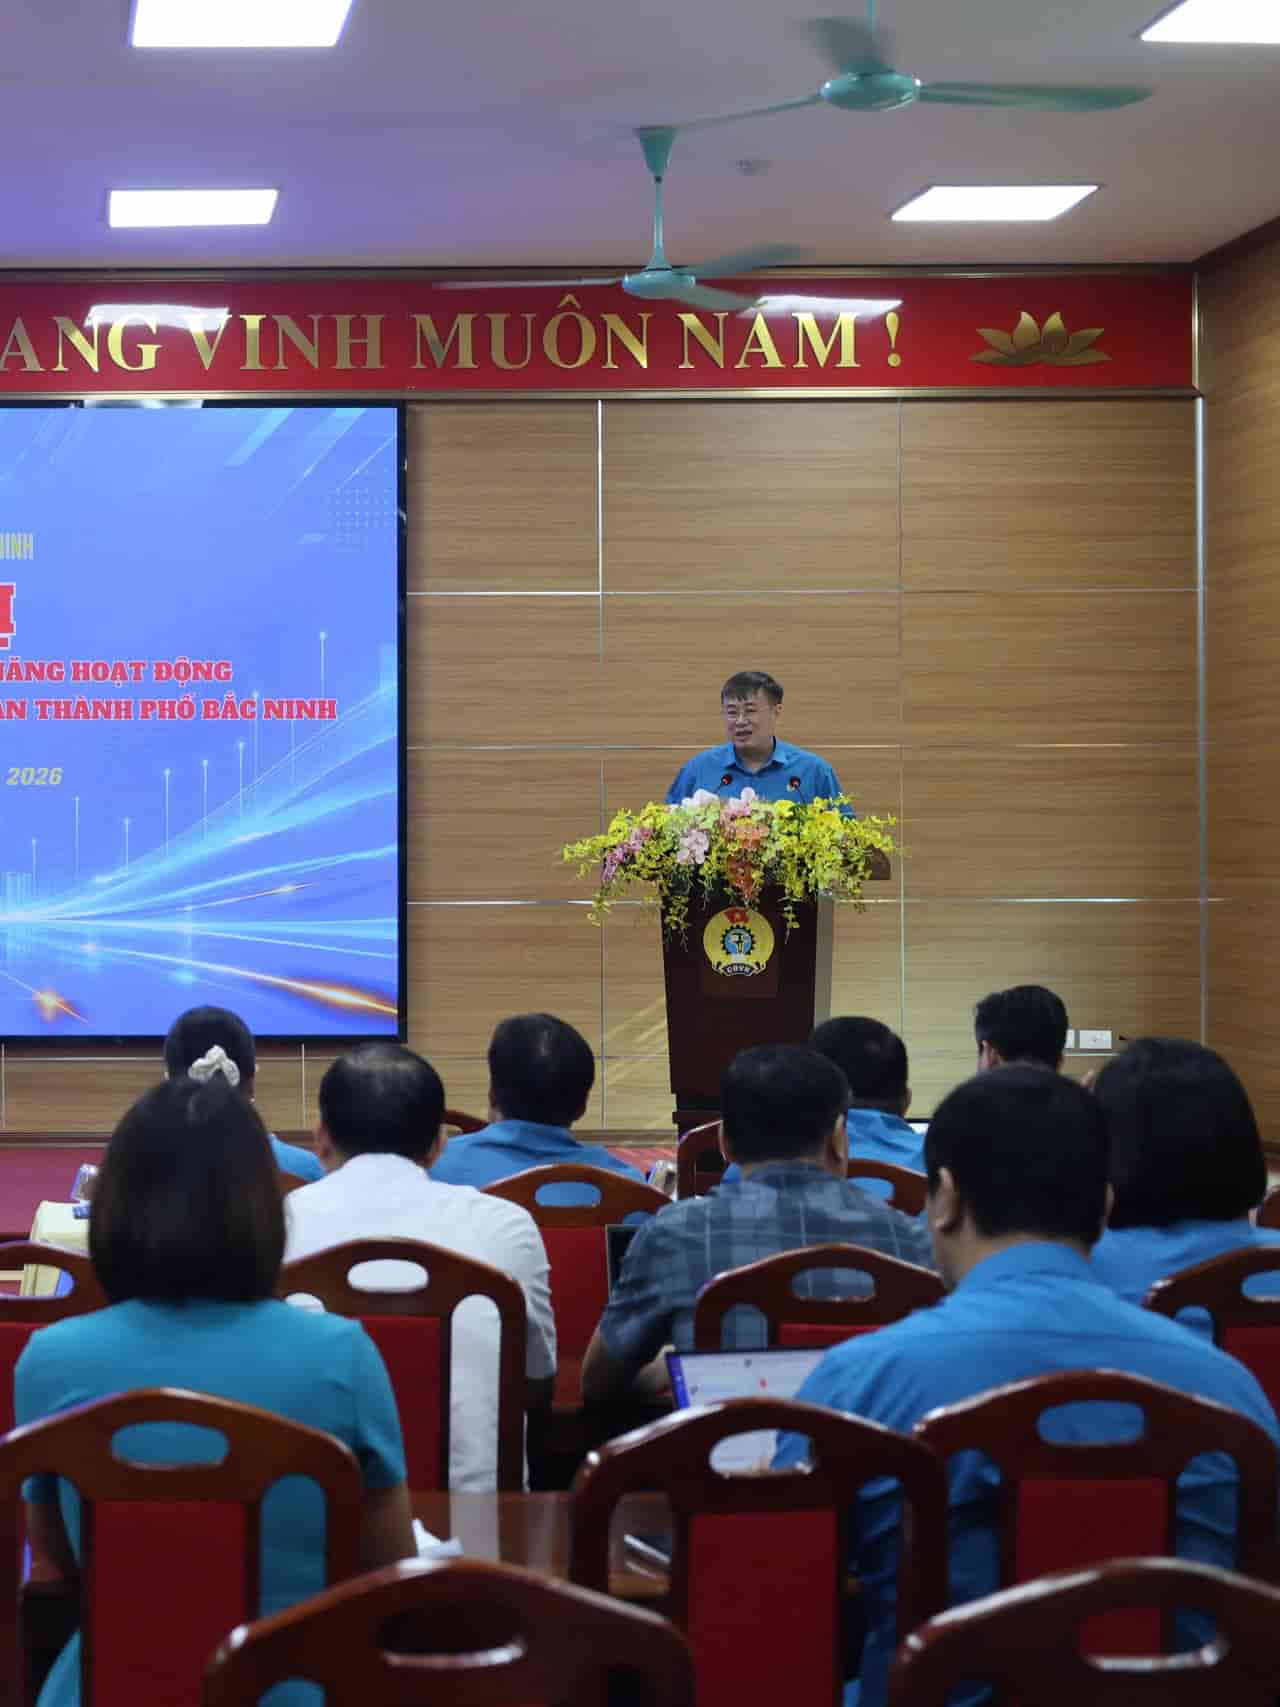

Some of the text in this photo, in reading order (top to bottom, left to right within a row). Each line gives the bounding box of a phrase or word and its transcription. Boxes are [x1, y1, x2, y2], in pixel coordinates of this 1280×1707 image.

[177, 313, 388, 371] VINH
[410, 293, 653, 370] MUÔN
[885, 311, 903, 368] !
[71, 660, 146, 688] HOẠT
[152, 656, 233, 688] ĐỘNG
[34, 696, 134, 720] THÀNH
[138, 692, 196, 720] PHỐ
[202, 690, 258, 720] BẮC
[263, 699, 338, 720] NINH
[6, 767, 64, 785] 2026
